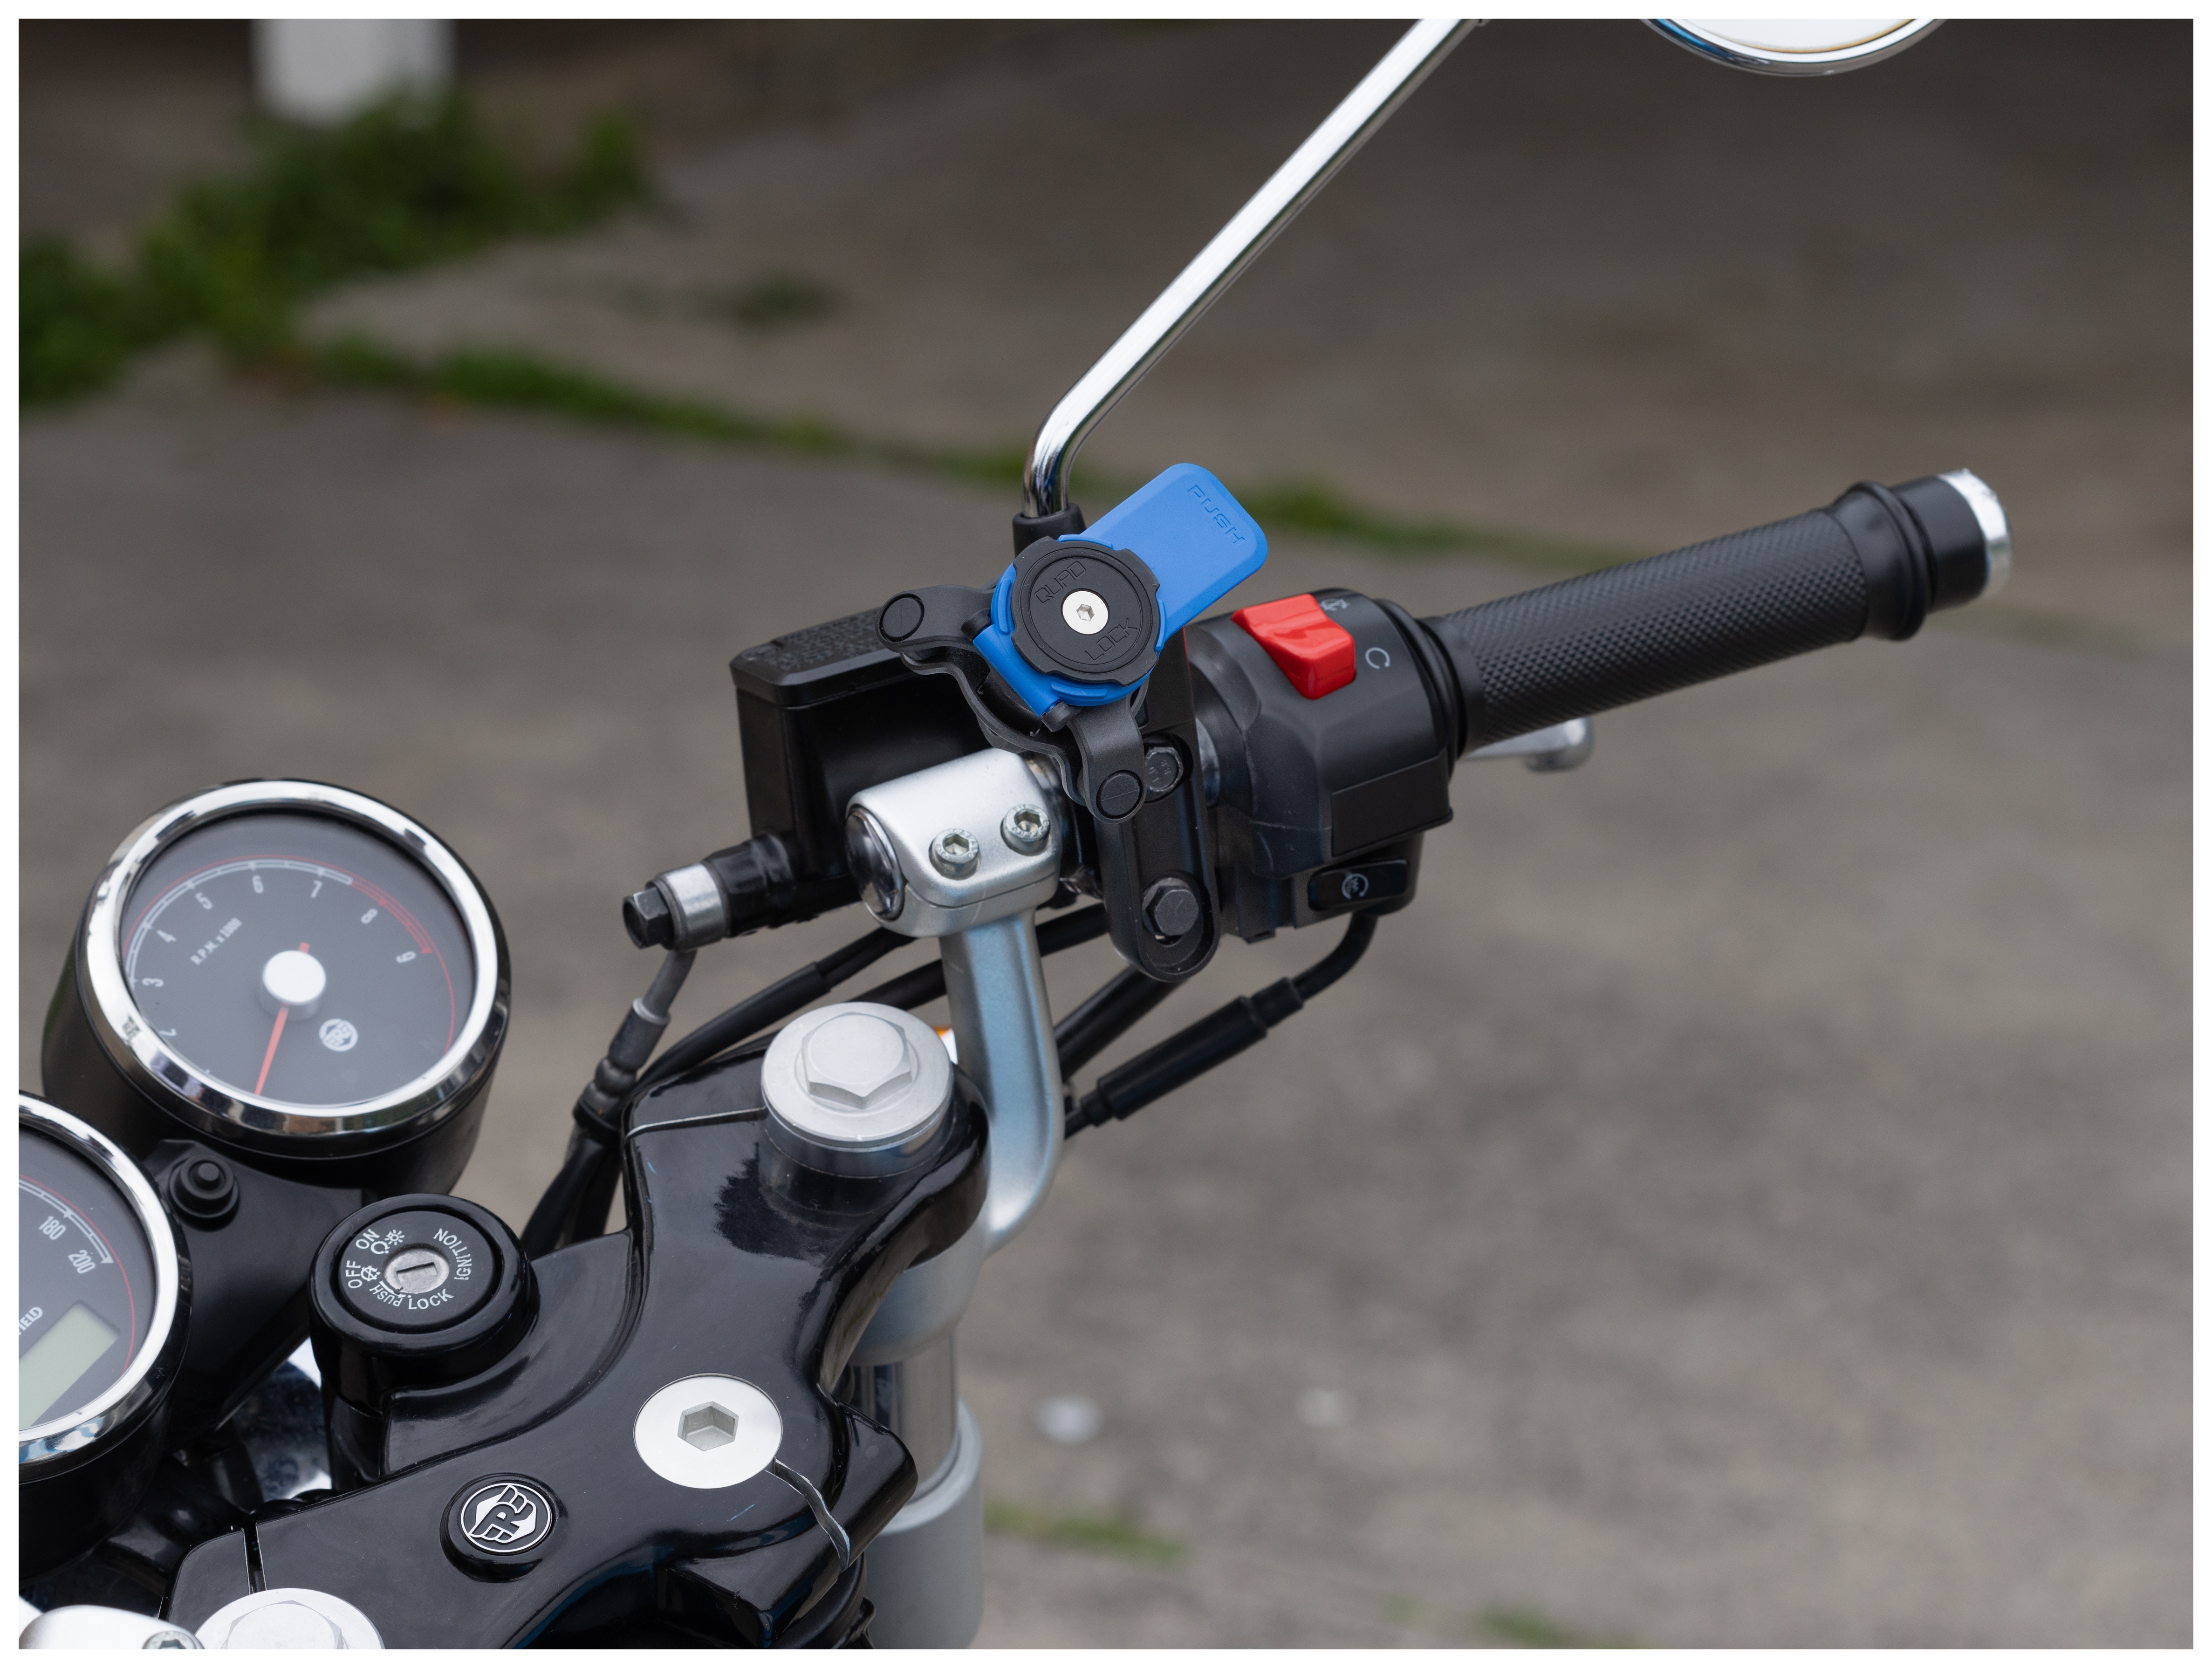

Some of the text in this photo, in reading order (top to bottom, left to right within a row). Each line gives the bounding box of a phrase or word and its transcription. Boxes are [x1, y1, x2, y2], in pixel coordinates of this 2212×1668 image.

[1187, 485, 1245, 547] PUSH
[1034, 561, 1086, 603] QUAD
[1084, 617, 1138, 661] LOCK
[252, 875, 264, 894] 6
[311, 880, 322, 898] 7
[195, 892, 212, 909] 5
[361, 909, 377, 924] 8
[157, 930, 177, 943] 4
[396, 951, 416, 963] 9
[142, 978, 164, 987] 3
[39, 1216, 66, 1240] 180
[356, 1229, 380, 1249] ON
[68, 1249, 96, 1274] 200
[433, 1228, 472, 1280] IGNITION
[345, 1260, 363, 1288] OFF
[369, 1284, 403, 1307] PUSH
[408, 1288, 454, 1310] LOCK
[19, 1306, 43, 1336] IELD
